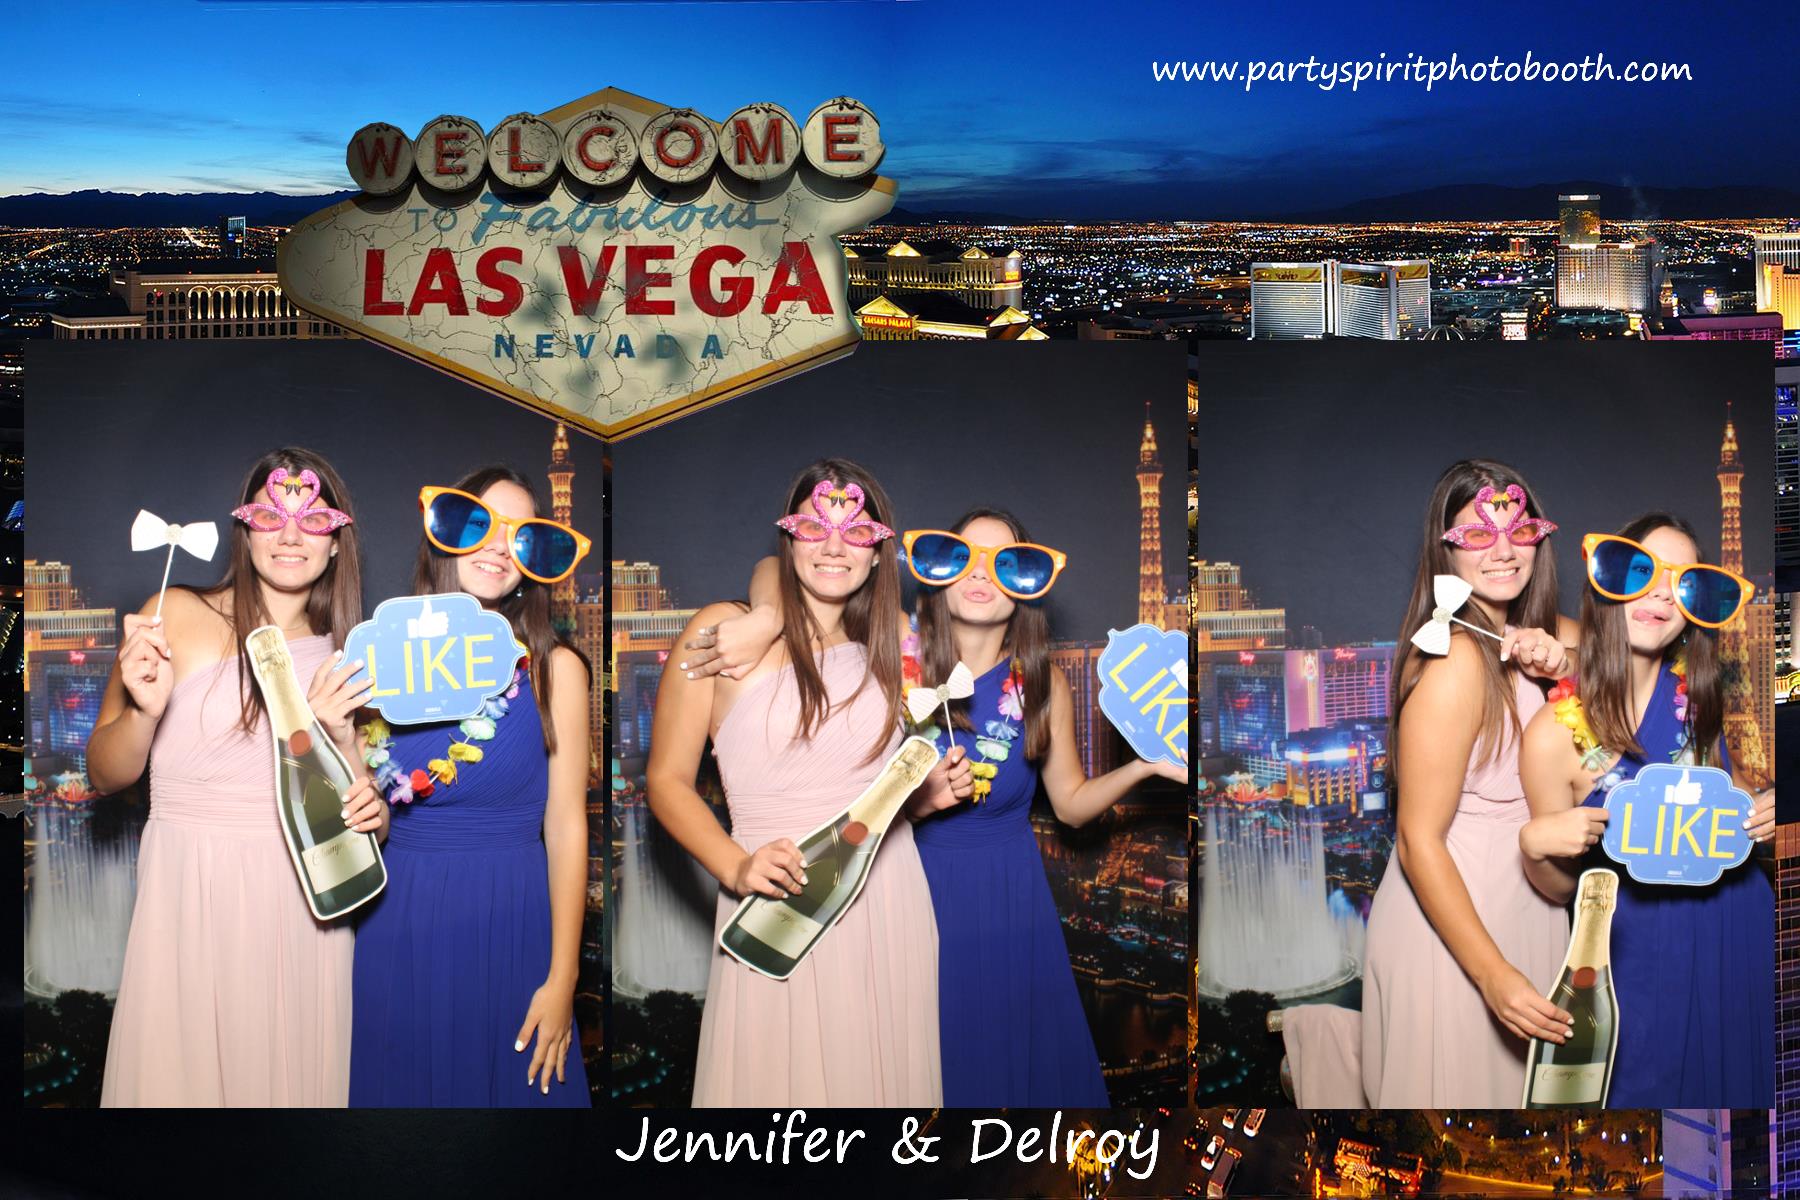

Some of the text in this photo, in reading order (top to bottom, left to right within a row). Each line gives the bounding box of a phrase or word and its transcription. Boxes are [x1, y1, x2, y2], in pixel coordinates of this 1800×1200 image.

[353, 114, 864, 180] WELCOME
[407, 191, 780, 245] TO Fabulous
[362, 241, 834, 317] LAS VEGA
[494, 333, 725, 360] NEVADA
[367, 634, 497, 697] LIKE
[1620, 802, 1739, 859] LIKE
